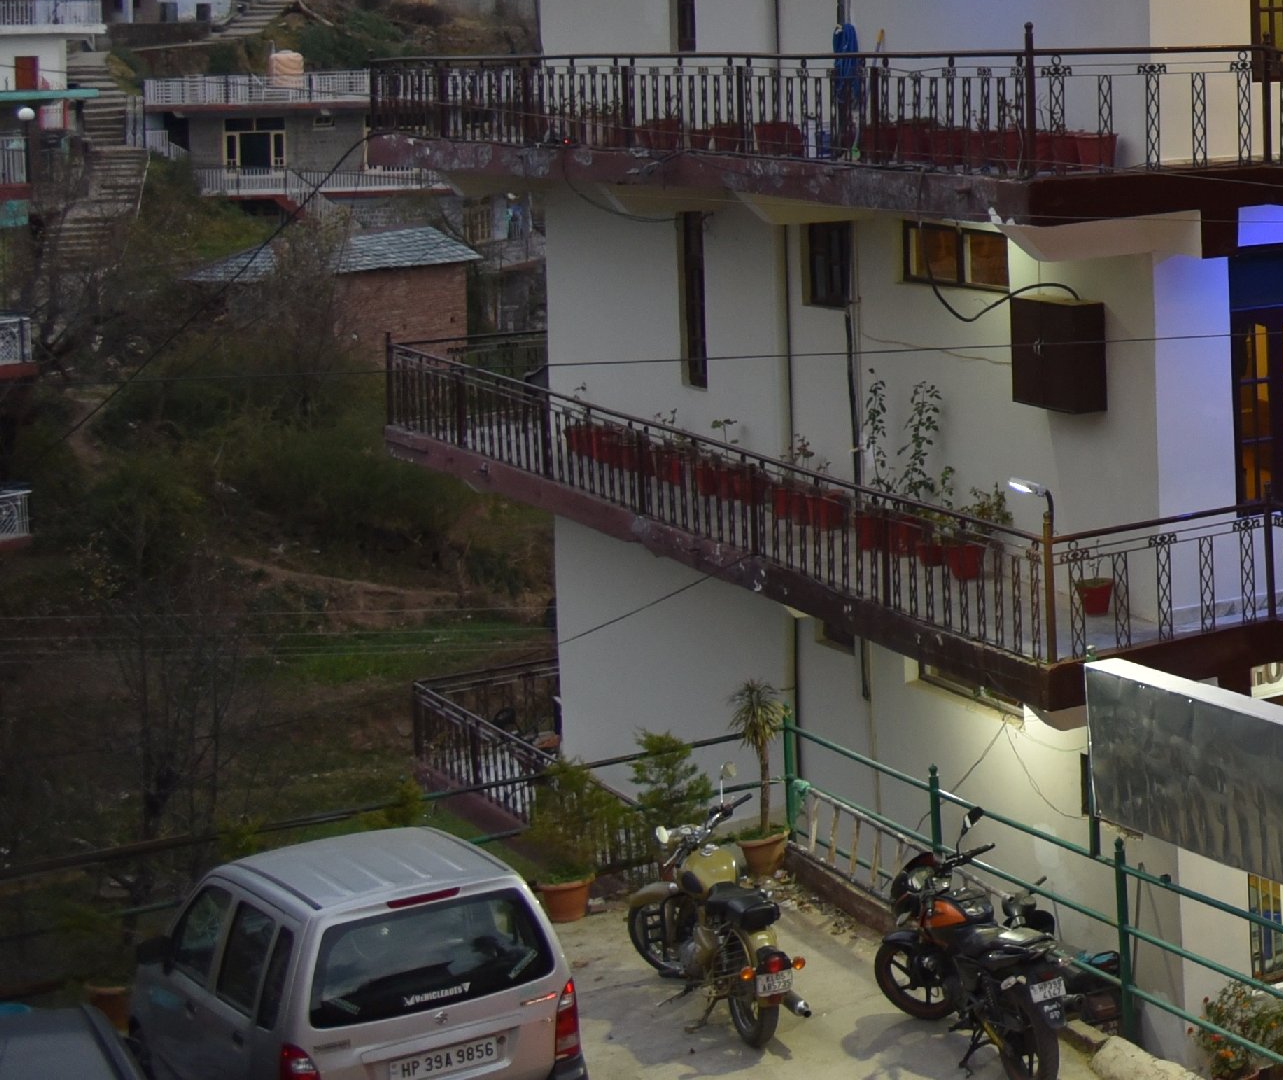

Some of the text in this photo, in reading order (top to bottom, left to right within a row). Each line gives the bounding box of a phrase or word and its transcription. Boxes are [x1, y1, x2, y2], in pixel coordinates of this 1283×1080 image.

[401, 1041, 494, 1078] HP 39A 9856
